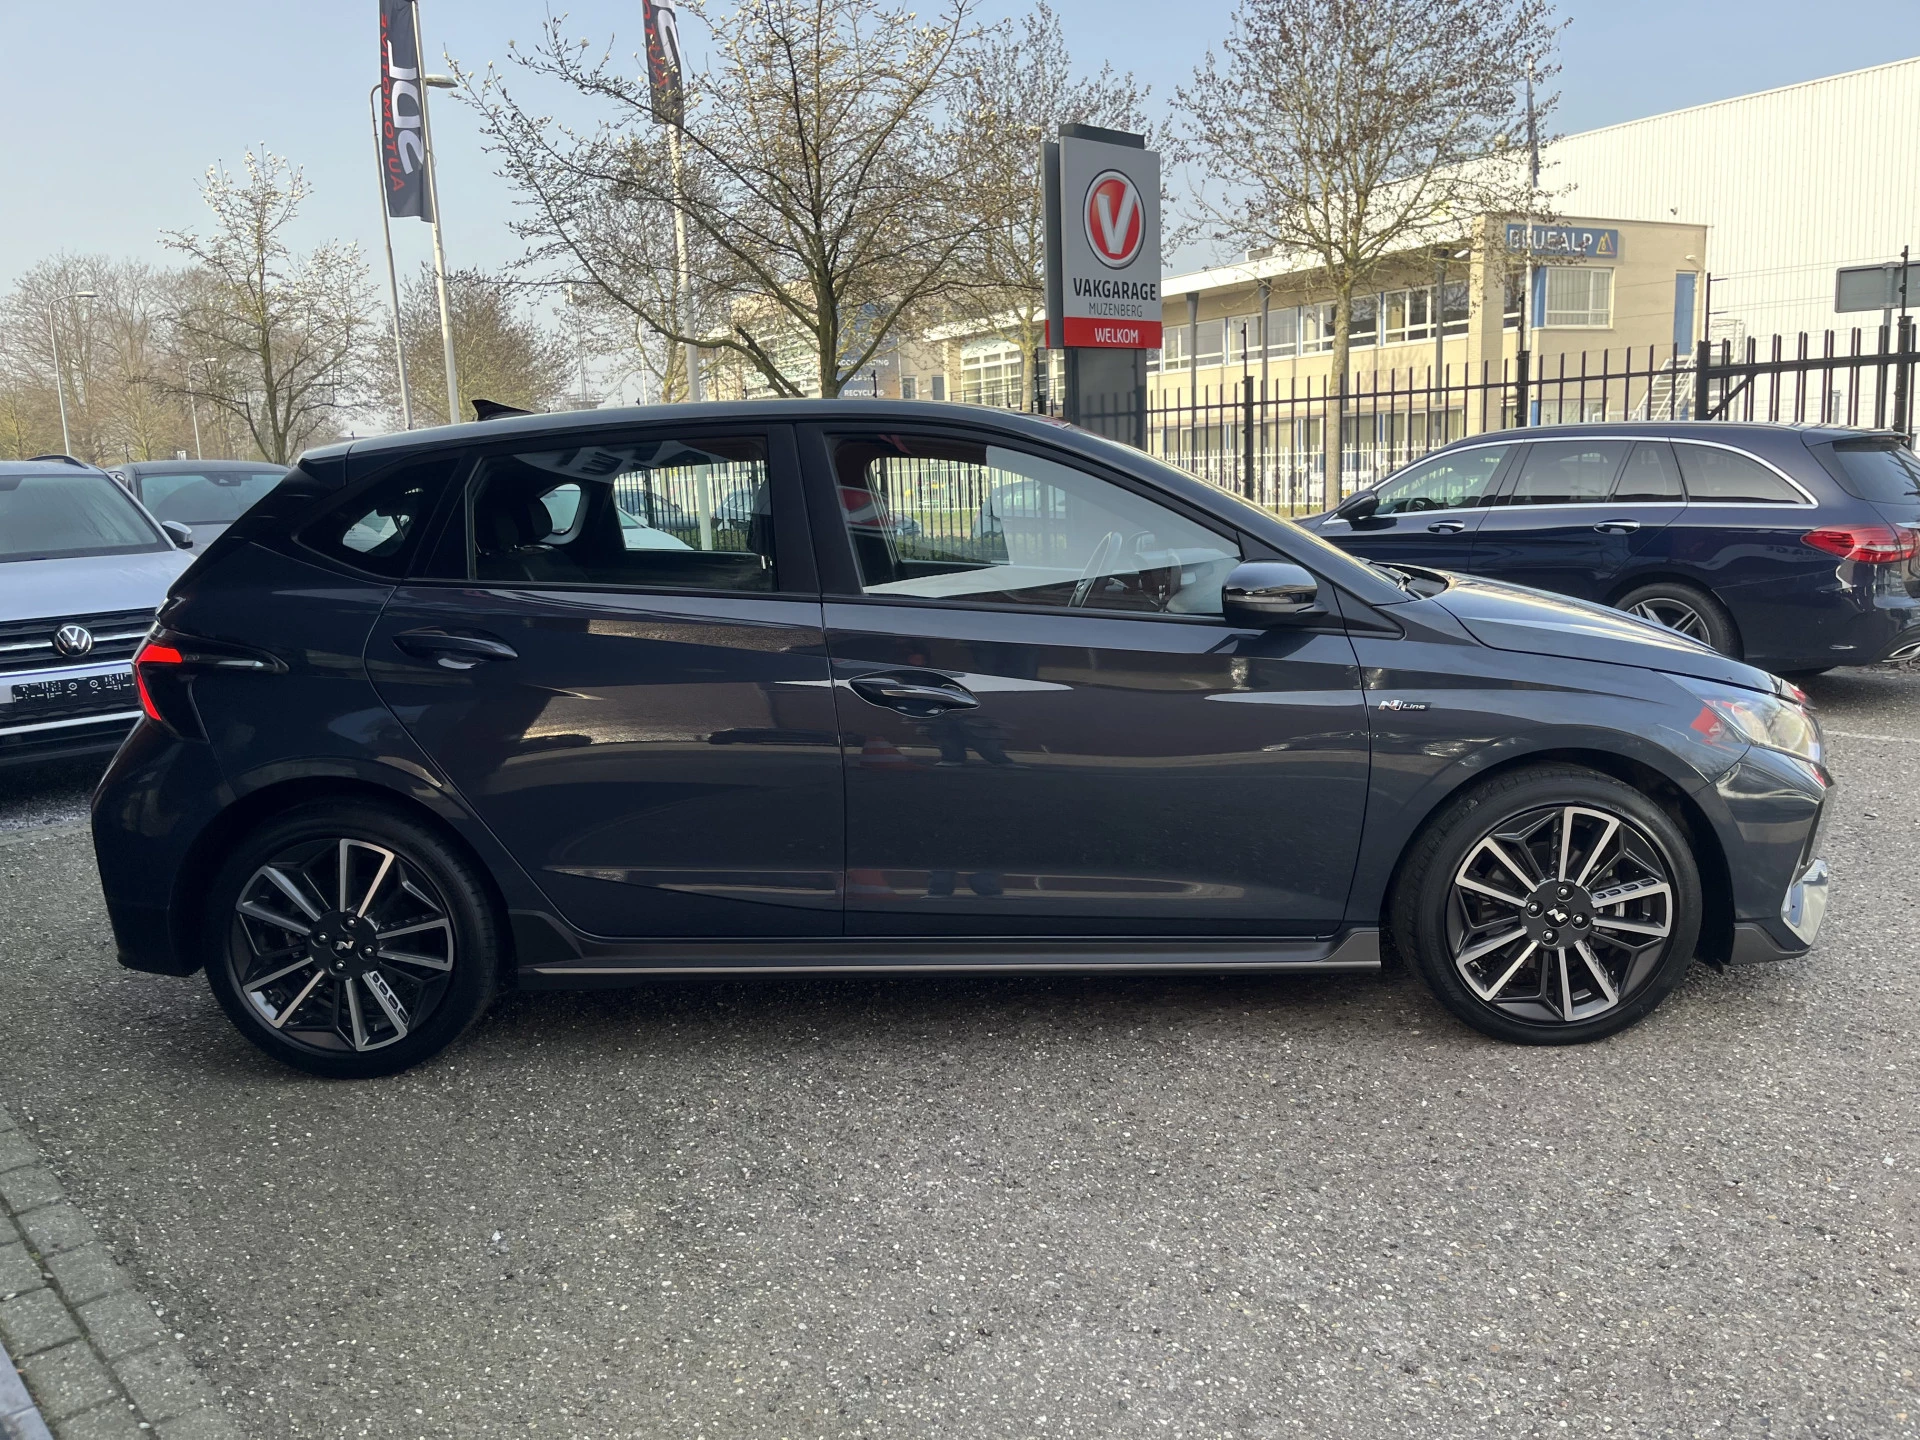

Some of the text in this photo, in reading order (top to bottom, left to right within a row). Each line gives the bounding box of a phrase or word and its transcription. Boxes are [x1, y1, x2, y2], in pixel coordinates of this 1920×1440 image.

[1509, 229, 1593, 251] BLUEALP
[1073, 277, 1156, 301] VAKGARAGE
[1088, 302, 1143, 317] MUZENBERG
[1094, 327, 1139, 344] WELKOM
